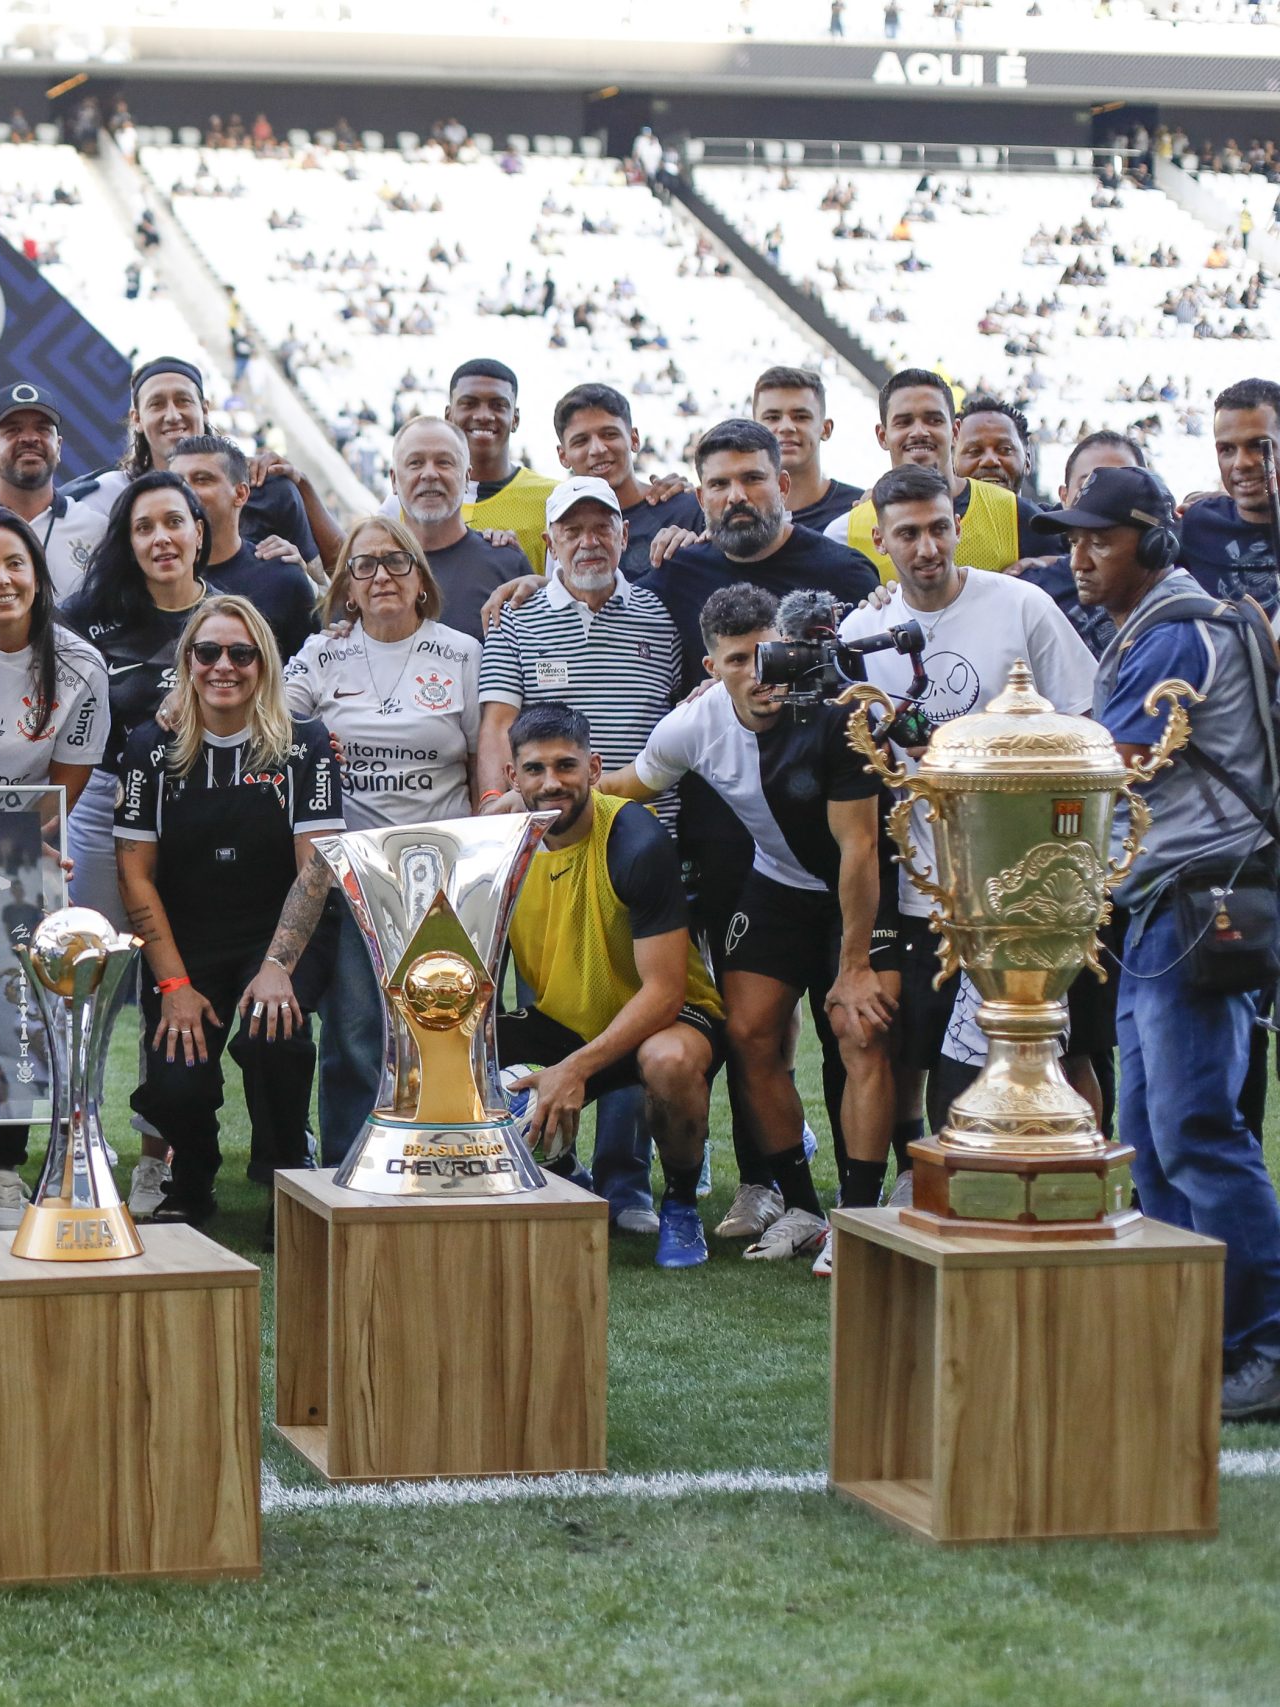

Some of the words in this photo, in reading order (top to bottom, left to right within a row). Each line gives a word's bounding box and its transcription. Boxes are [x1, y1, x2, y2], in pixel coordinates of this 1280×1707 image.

[873, 51, 984, 87] AQUI
[997, 48, 1028, 88] É
[66, 709, 95, 746] bmg
[126, 769, 147, 808] bmg
[309, 771, 331, 811] bmg
[386, 1158, 519, 1177] CHEVROLET
[56, 1219, 115, 1243] FIFA
